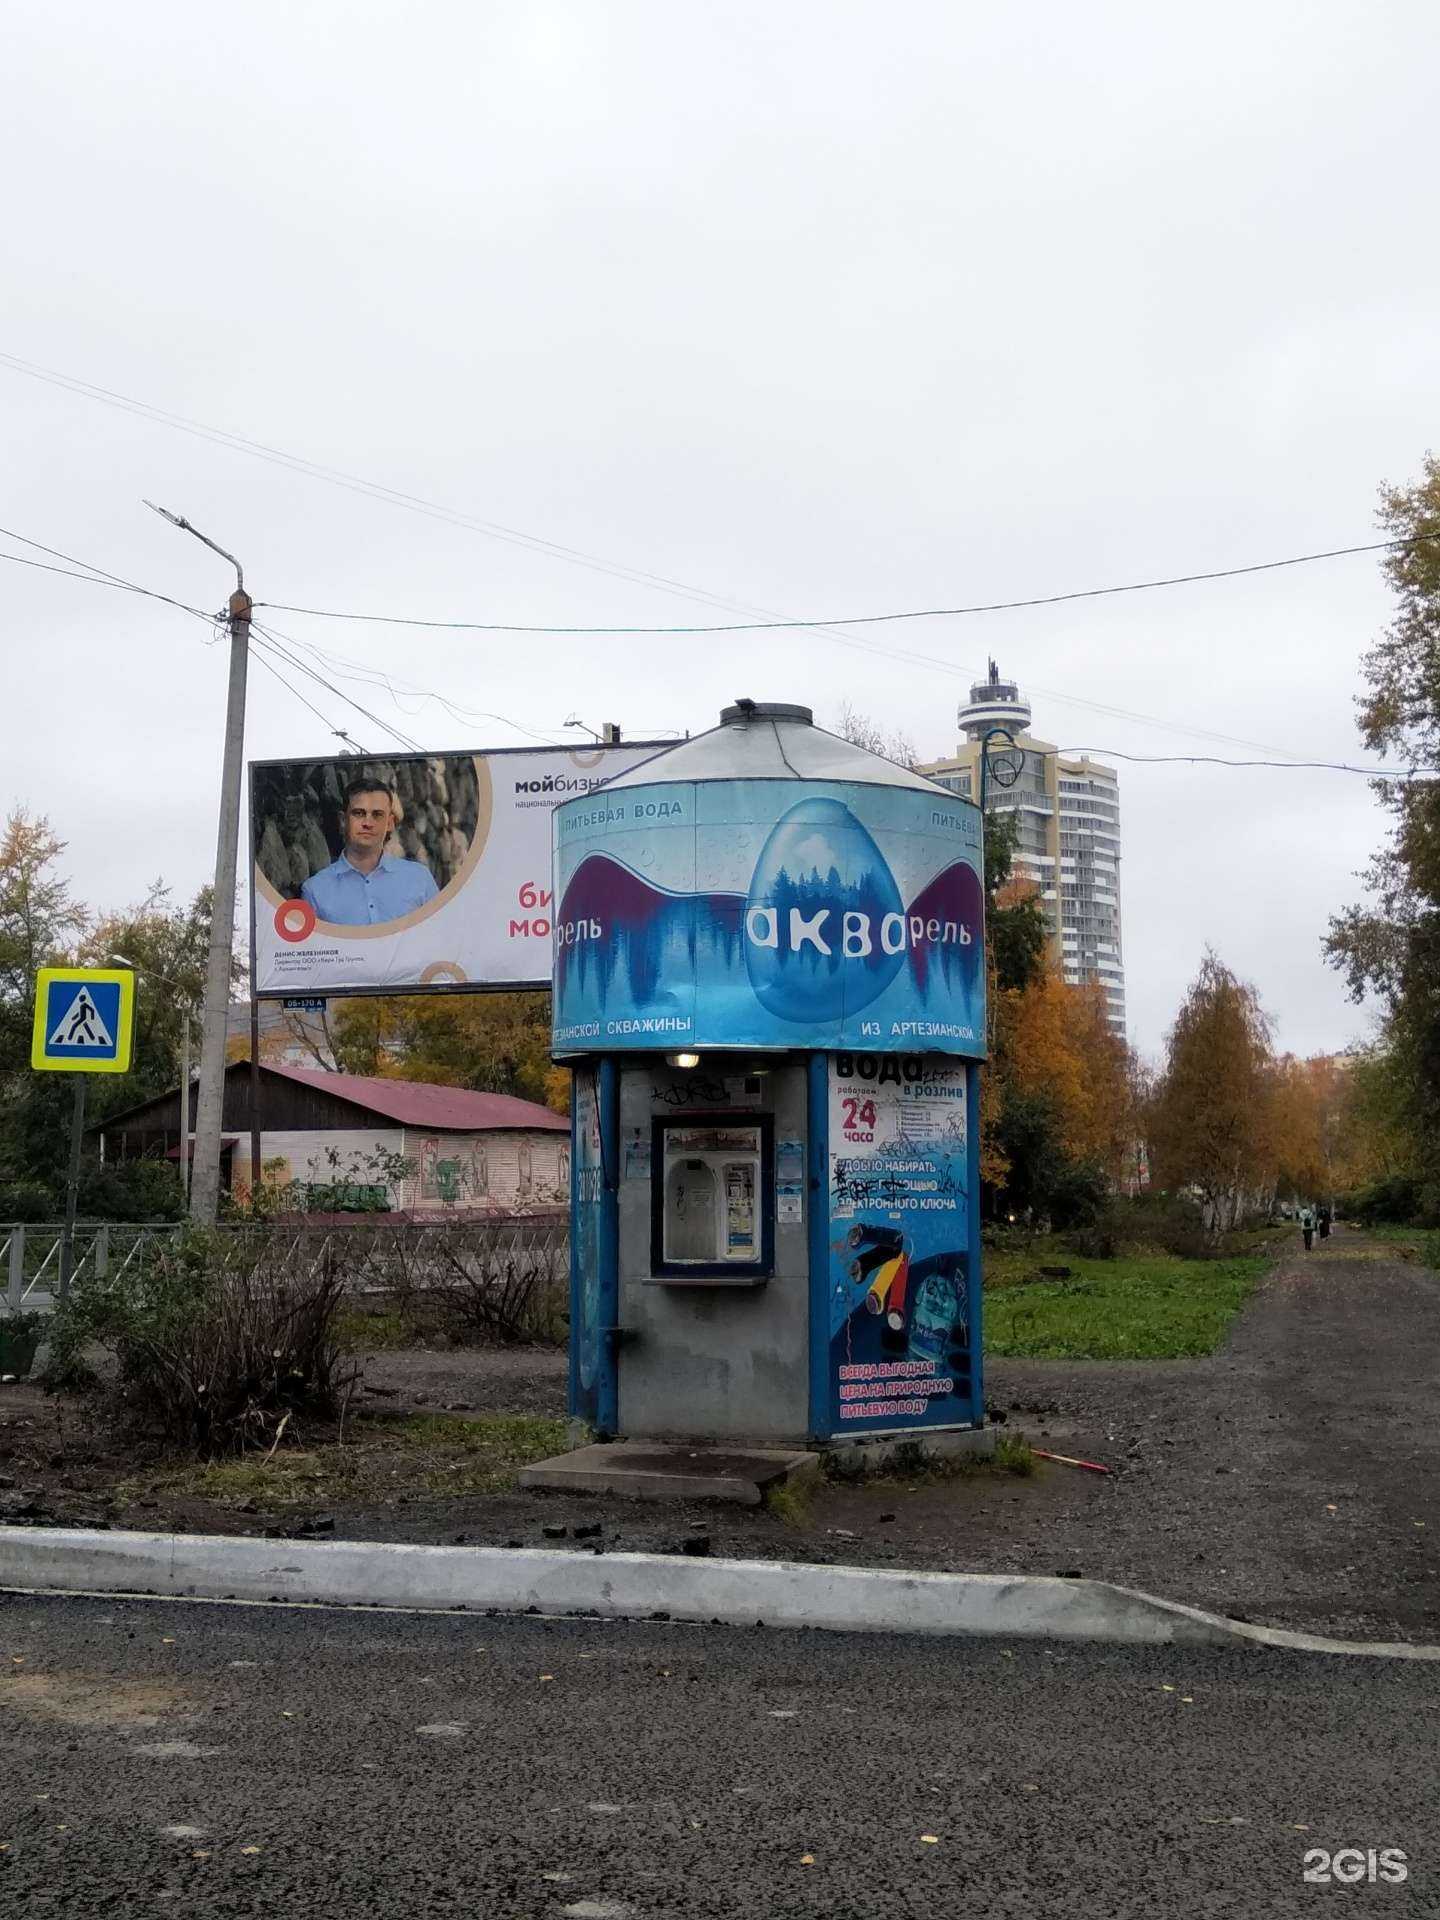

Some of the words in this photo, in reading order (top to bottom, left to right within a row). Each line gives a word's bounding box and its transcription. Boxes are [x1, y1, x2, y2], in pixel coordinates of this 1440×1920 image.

[565, 807, 625, 831] ПИТЬЕВАЯ
[634, 801, 682, 818] ВОДА
[607, 1016, 691, 1035] СКВАЖИНЫ
[861, 1022, 881, 1036] ИЗ
[891, 1022, 974, 1040] АРТЕЗИАНСКОЙ
[915, 1085, 963, 1099] розлив
[842, 1098, 877, 1129] 24
[844, 1131, 875, 1143] часа
[885, 1161, 937, 1173] НАБИРАТЬ
[878, 1179, 938, 1192] ПОЩЬЮ
[920, 1198, 957, 1210] КЛЮЧА
[840, 1365, 877, 1379] ВСЕГДА
[879, 1361, 935, 1377] ВЫГОДНАЯ
[840, 1384, 868, 1400] ЦЕНА
[869, 1382, 886, 1397] НА
[886, 1378, 954, 1396] ПРИРОДНУЮ
[840, 1401, 897, 1418] ПИТЬЕВУЮ
[898, 1399, 928, 1415] ВОДУ
